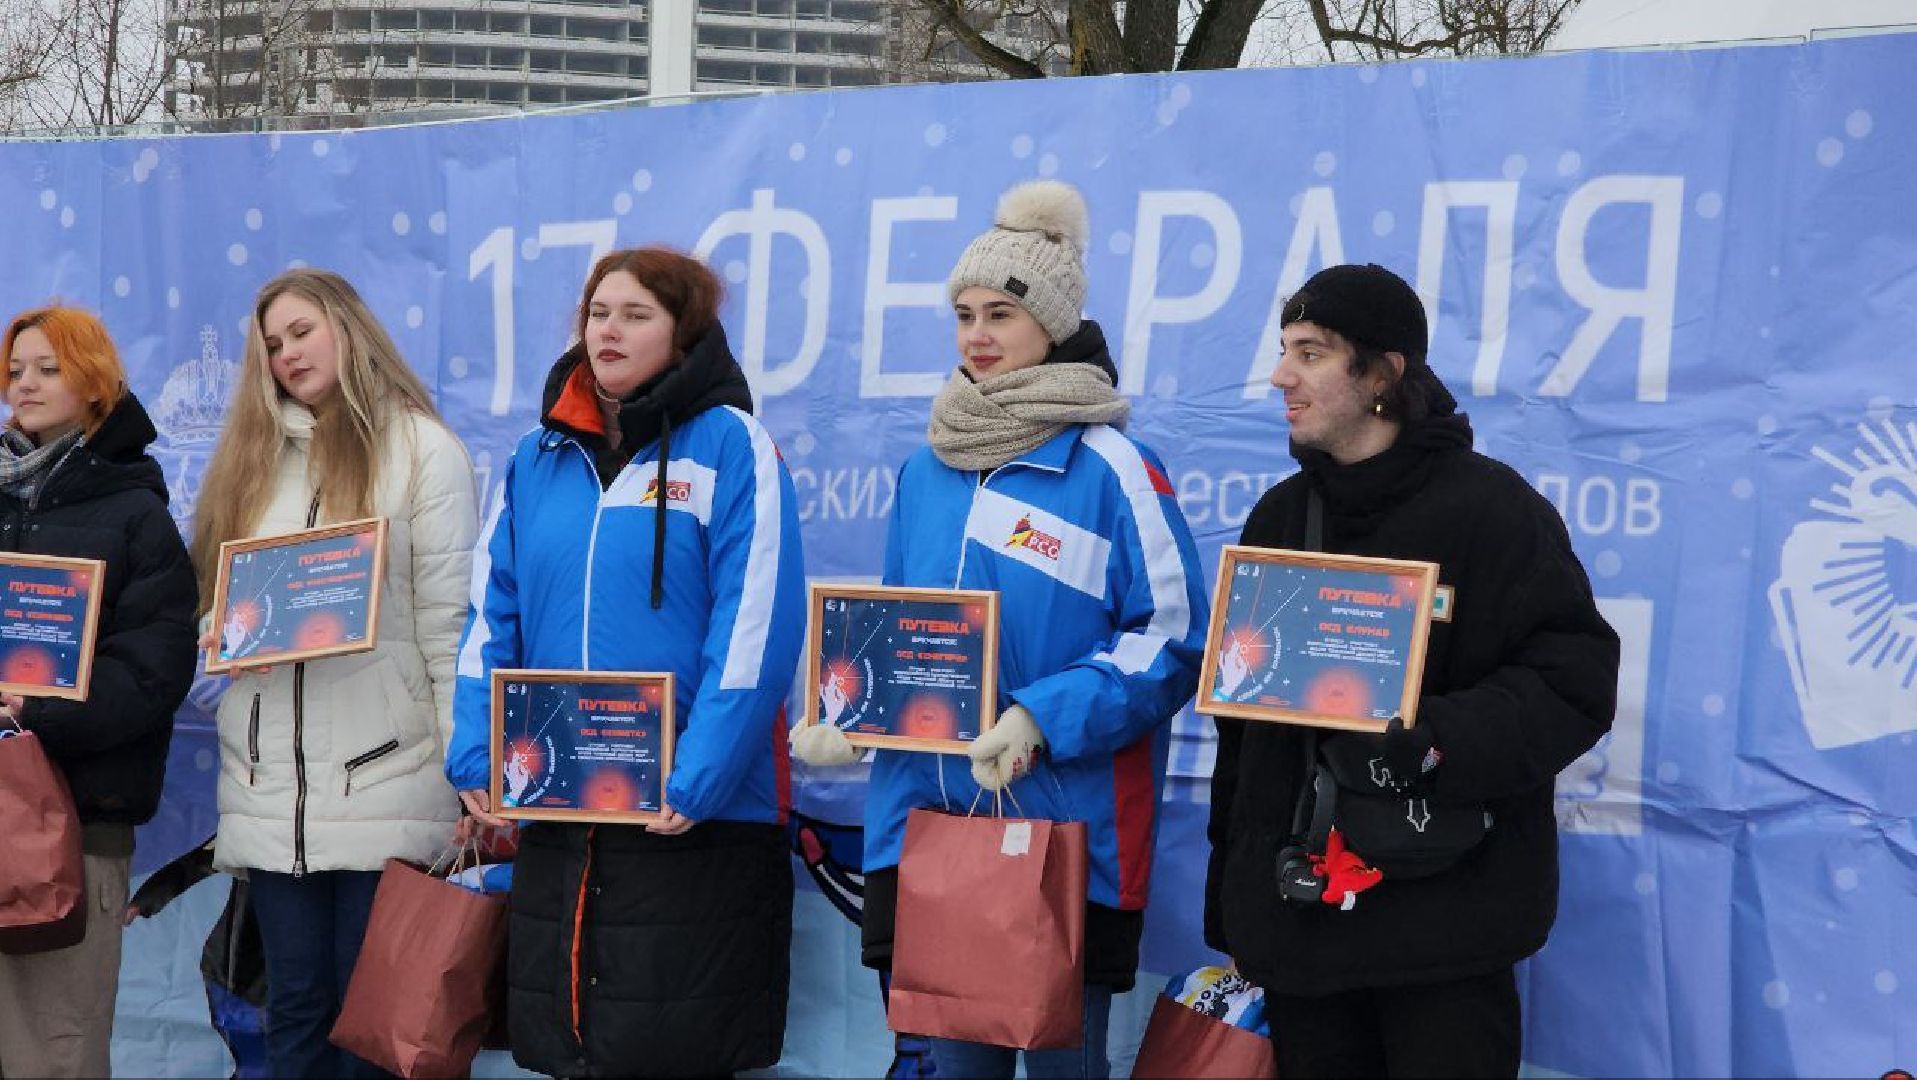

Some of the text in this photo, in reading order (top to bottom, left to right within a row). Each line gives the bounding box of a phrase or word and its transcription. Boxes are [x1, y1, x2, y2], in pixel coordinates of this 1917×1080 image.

[469, 174, 1686, 416] 17 ФЕРАЛЯ
[1027, 535, 1060, 559] РСО
